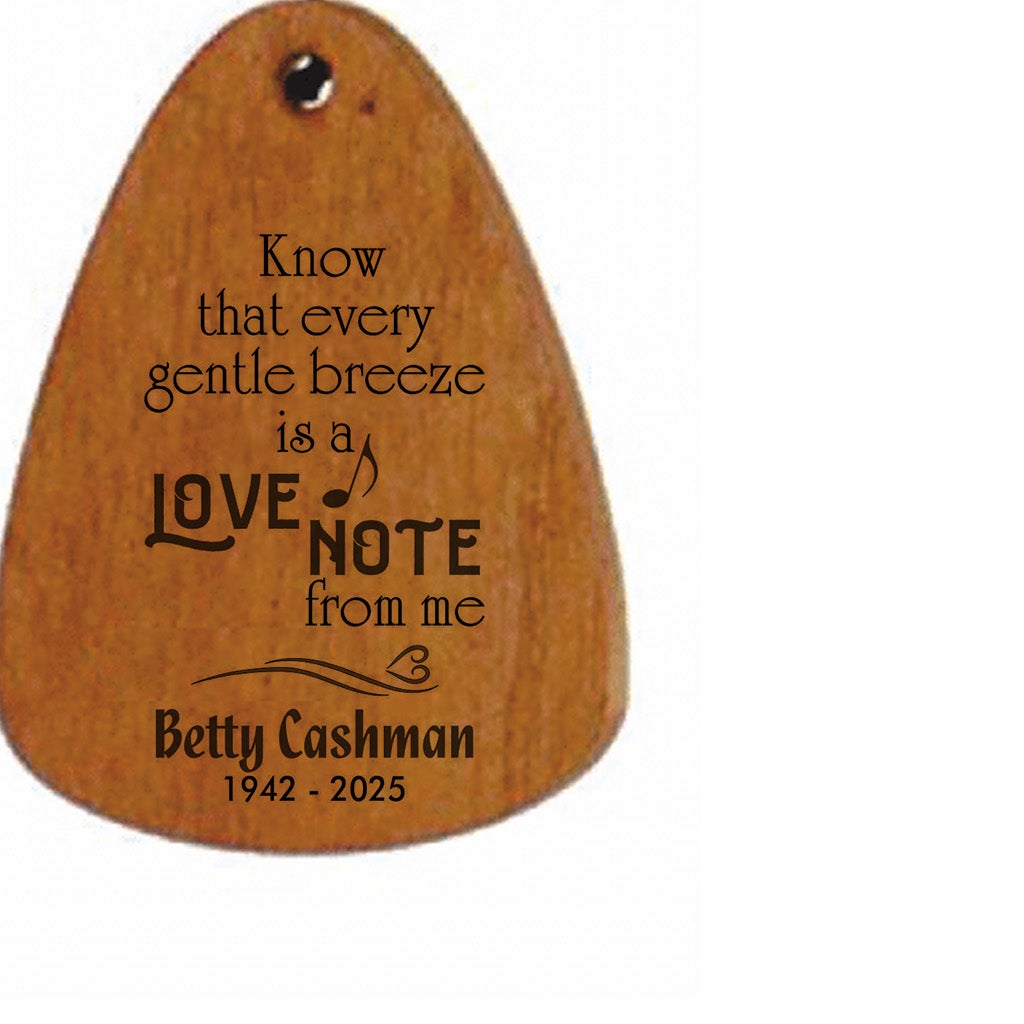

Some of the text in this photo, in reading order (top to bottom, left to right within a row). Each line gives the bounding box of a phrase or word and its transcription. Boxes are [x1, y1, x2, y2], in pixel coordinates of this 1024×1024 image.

[259, 234, 386, 277] Know
[198, 288, 435, 353] that every
[144, 347, 486, 413] gentle breeze
[277, 410, 354, 453] is a
[145, 474, 300, 552] LOVE
[310, 517, 481, 576] NOTE
[305, 577, 486, 627] from me
[155, 708, 474, 772] Betty Cashman
[224, 775, 296, 803] 1942
[330, 775, 406, 803] 2025
